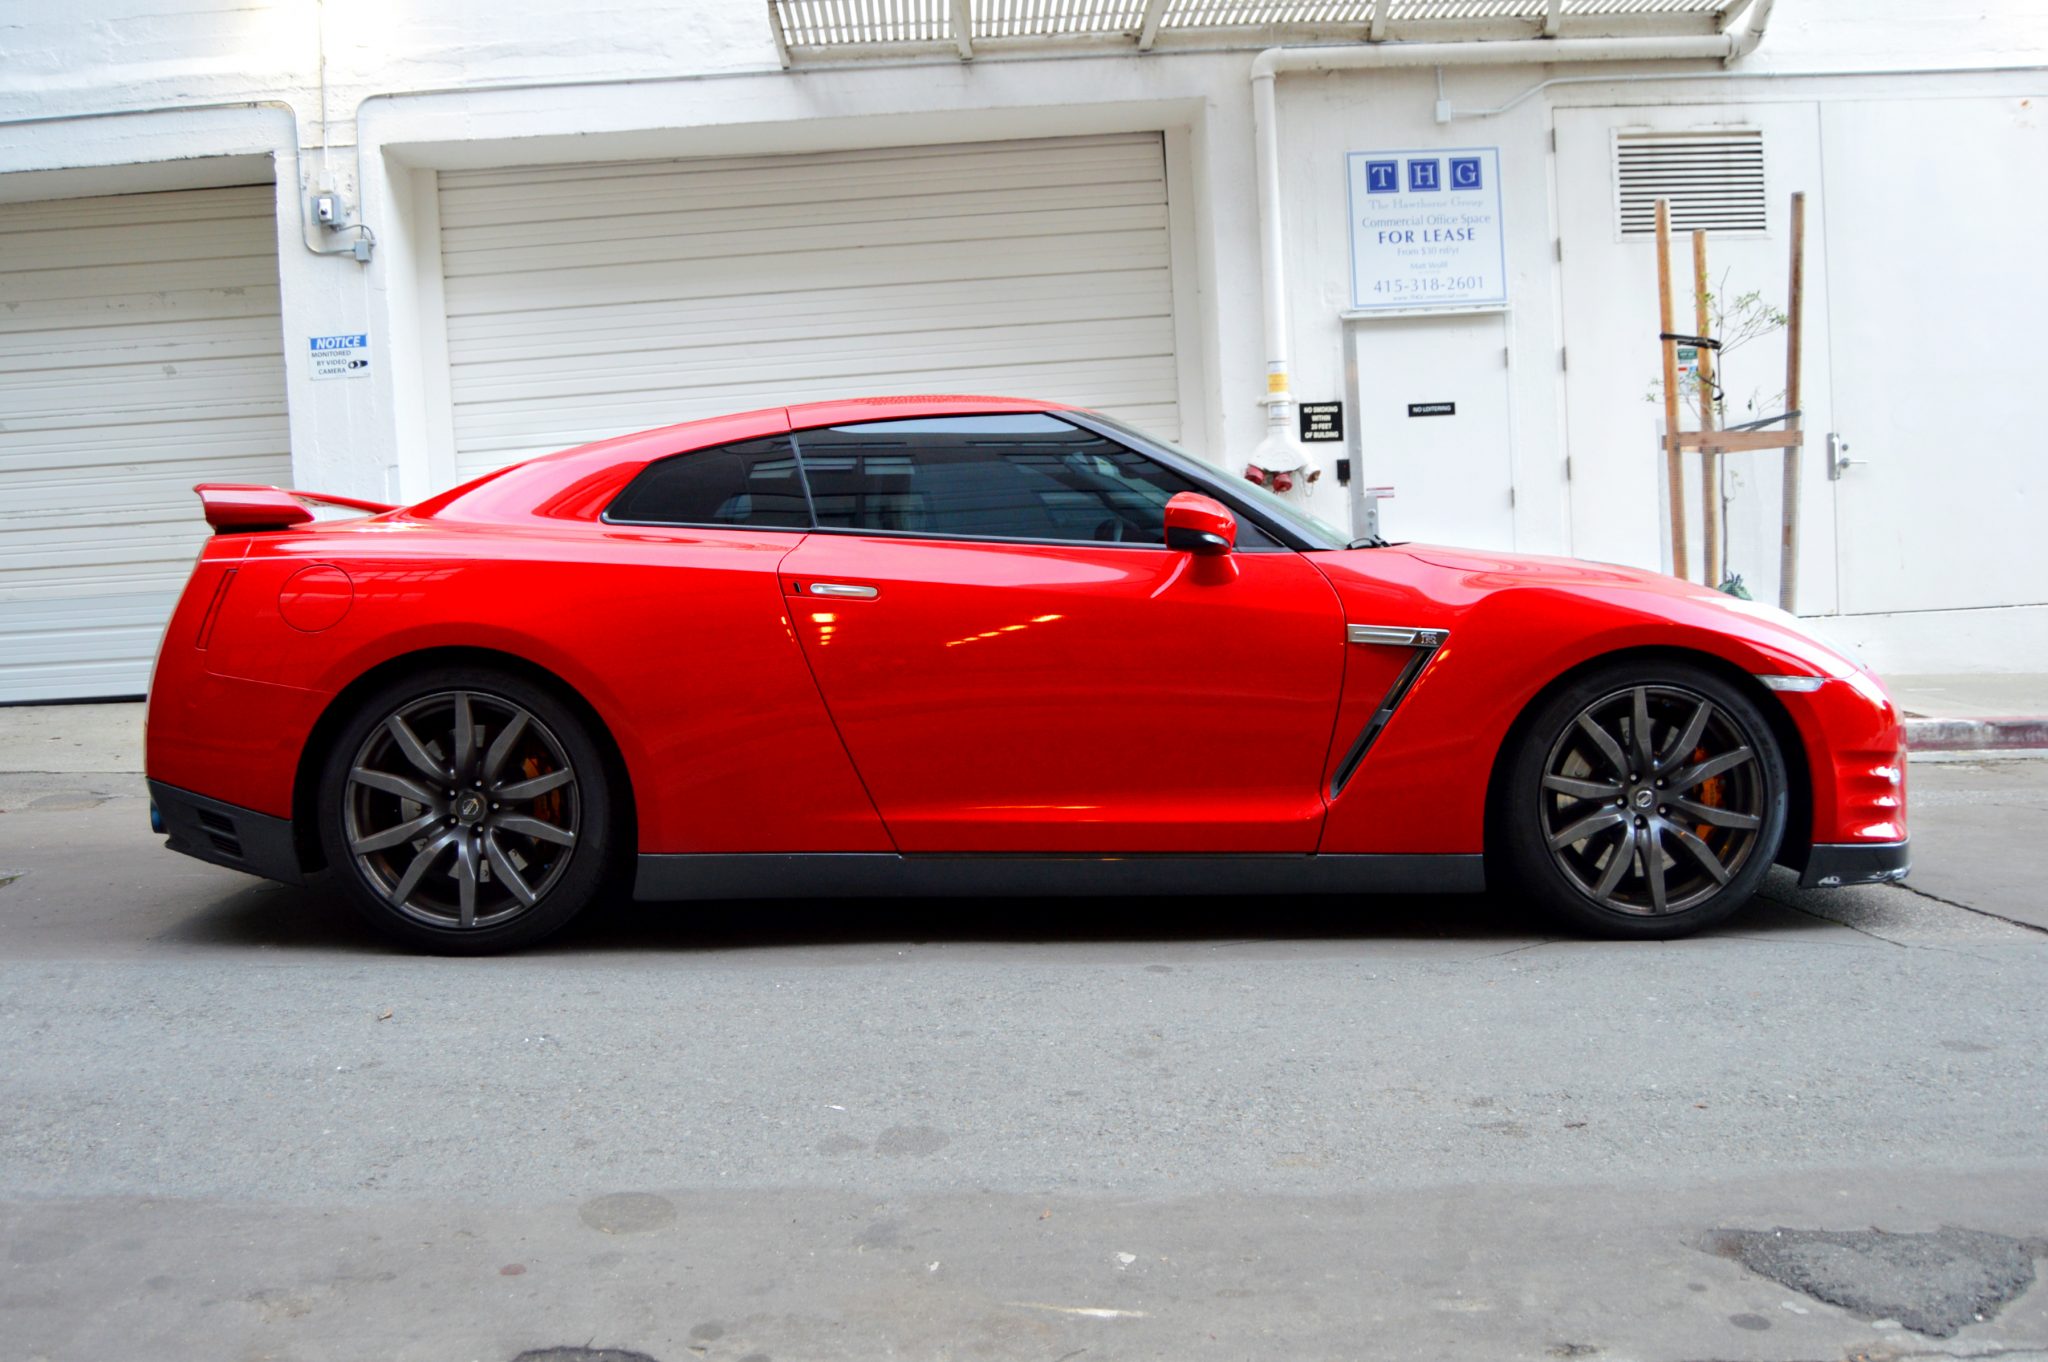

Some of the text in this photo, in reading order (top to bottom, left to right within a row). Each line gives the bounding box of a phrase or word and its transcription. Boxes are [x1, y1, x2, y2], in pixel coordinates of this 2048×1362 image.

[1368, 199, 1389, 210] The
[1450, 196, 1484, 208] Group
[1362, 212, 1491, 228] Commercial Office Space
[1378, 227, 1476, 245] FOR LEASE
[1374, 276, 1484, 293] 415-318-2601
[316, 335, 361, 349] NOTICE
[311, 350, 352, 358] MONITORED
[318, 367, 347, 375] CAMERA
[1303, 405, 1339, 414] NO SMOKING
[1412, 406, 1423, 414] NO
[1311, 414, 1332, 422] WITHIN
[1319, 422, 1333, 430] FEET
[1313, 431, 1339, 439] BUILDING
